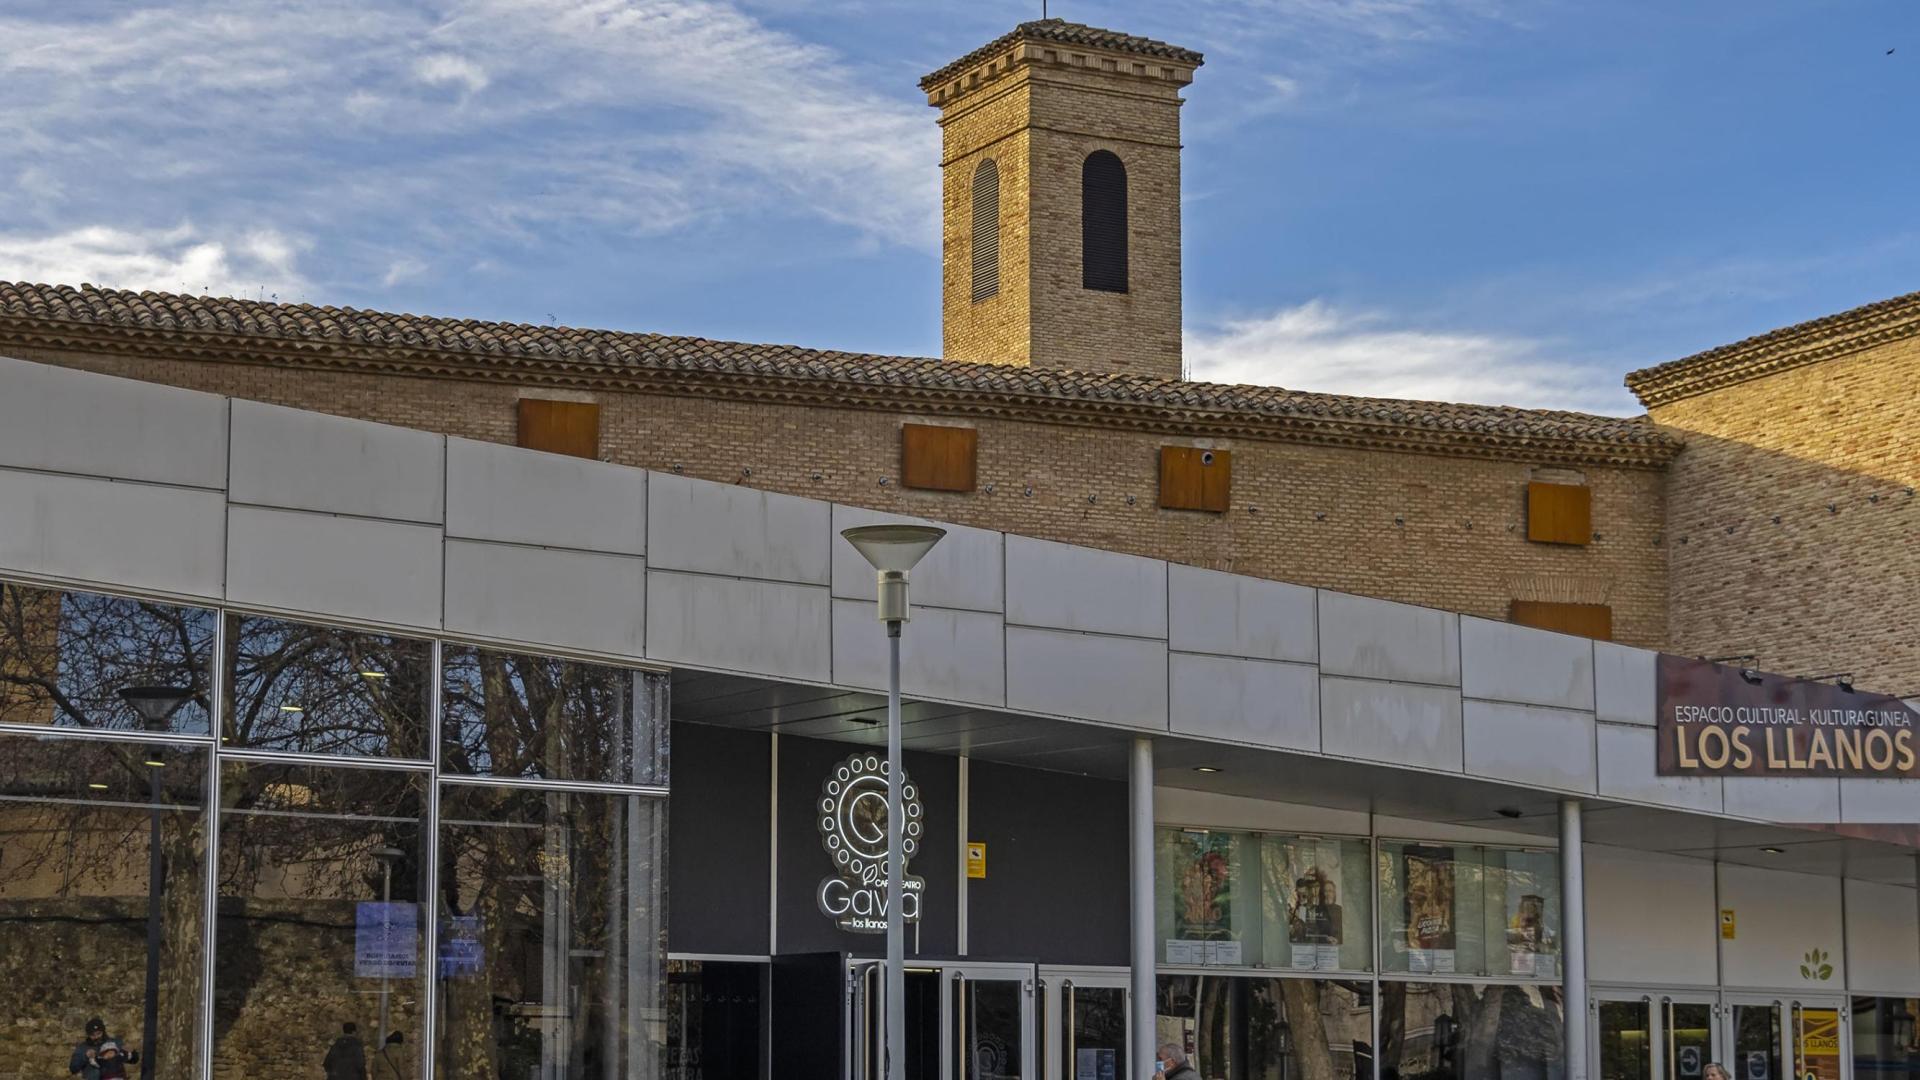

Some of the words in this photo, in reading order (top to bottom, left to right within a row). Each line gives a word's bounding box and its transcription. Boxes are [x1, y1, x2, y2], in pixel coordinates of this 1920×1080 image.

[1675, 705, 1734, 724] ESPACIO
[1809, 709, 1912, 727] KULTURAGUNEA
[1677, 725, 1753, 769] LOS
[1765, 727, 1915, 771] LLANOS
[901, 880, 921, 890] EATRO
[822, 879, 919, 919] Gava
[852, 918, 864, 929] los
[865, 918, 888, 930] llanos
[1810, 1039, 1839, 1049] LLANOS
